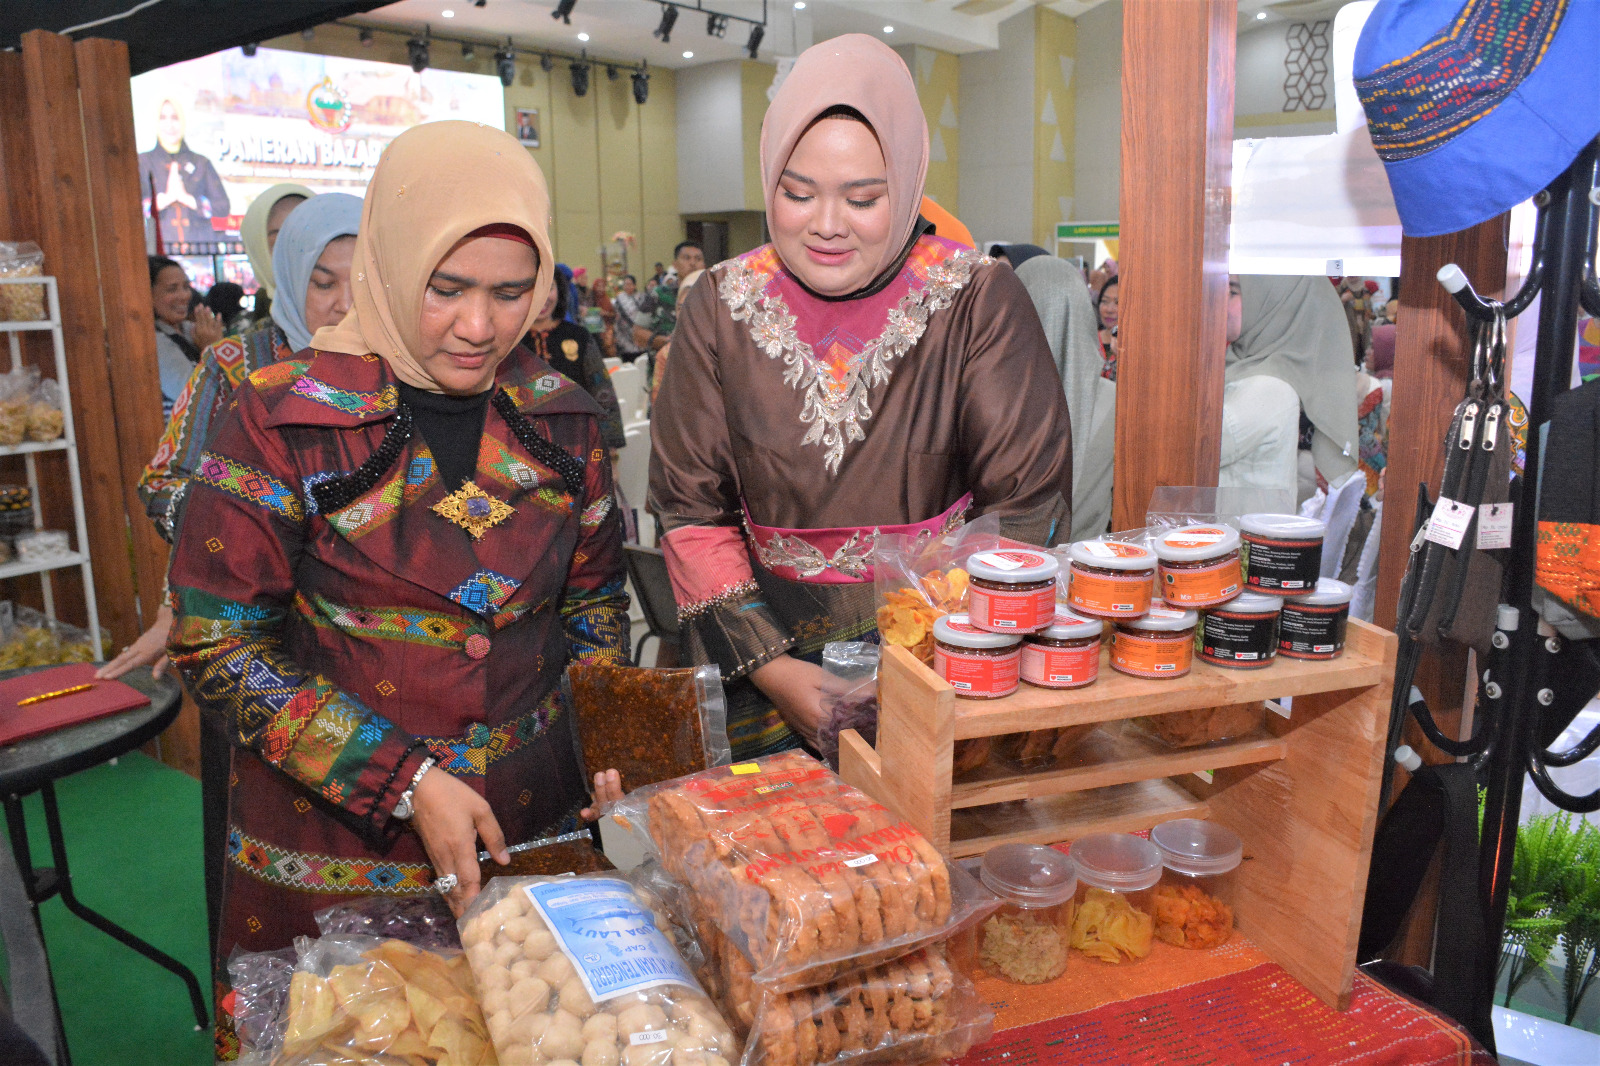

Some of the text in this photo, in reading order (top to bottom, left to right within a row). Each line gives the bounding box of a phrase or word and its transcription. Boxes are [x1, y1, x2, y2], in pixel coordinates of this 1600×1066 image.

[217, 135, 318, 166] PAMERAN
[572, 926, 623, 939] LAUT
[624, 942, 647, 953] CAP
[589, 957, 642, 988] TENGGIRI
[637, 957, 666, 977] IKAN
